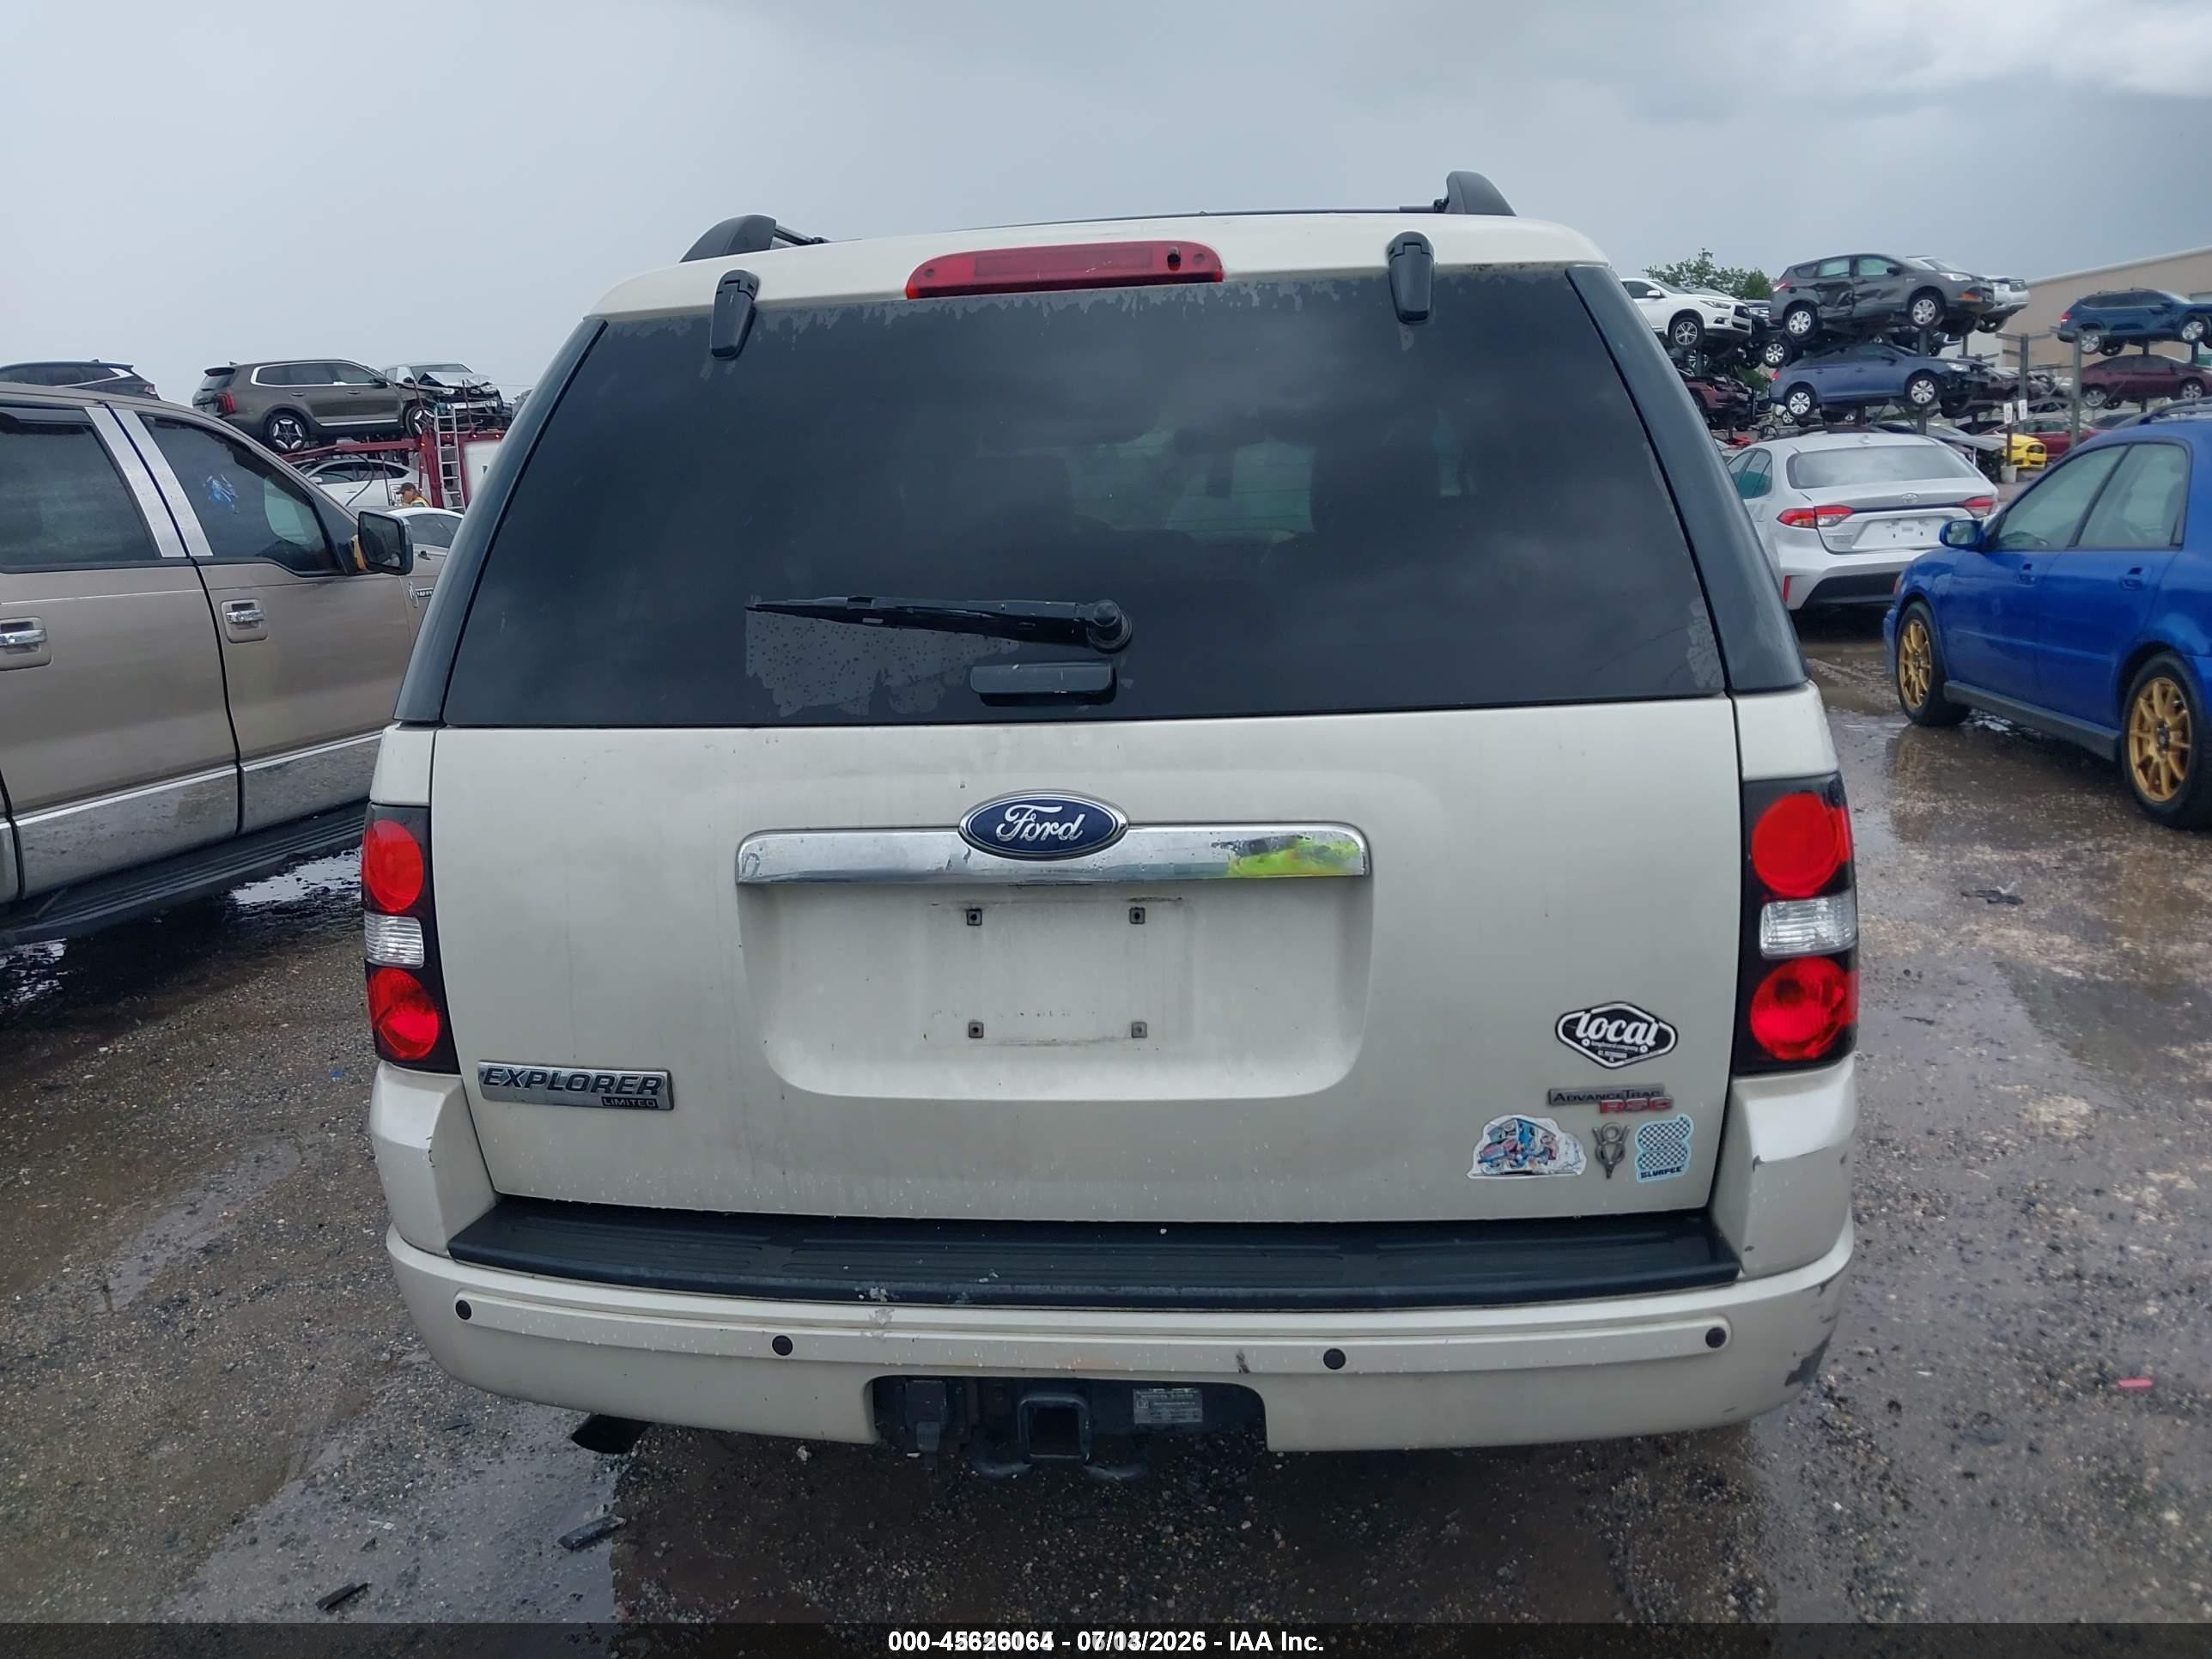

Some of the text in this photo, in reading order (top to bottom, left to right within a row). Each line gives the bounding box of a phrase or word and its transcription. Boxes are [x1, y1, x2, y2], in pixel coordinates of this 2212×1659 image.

[996, 804, 1085, 842] Ford
[1575, 1012, 1660, 1048] local
[483, 1066, 665, 1096] EXPLORER
[602, 1097, 658, 1108] LIMITED
[1600, 1096, 1674, 1114] RSC
